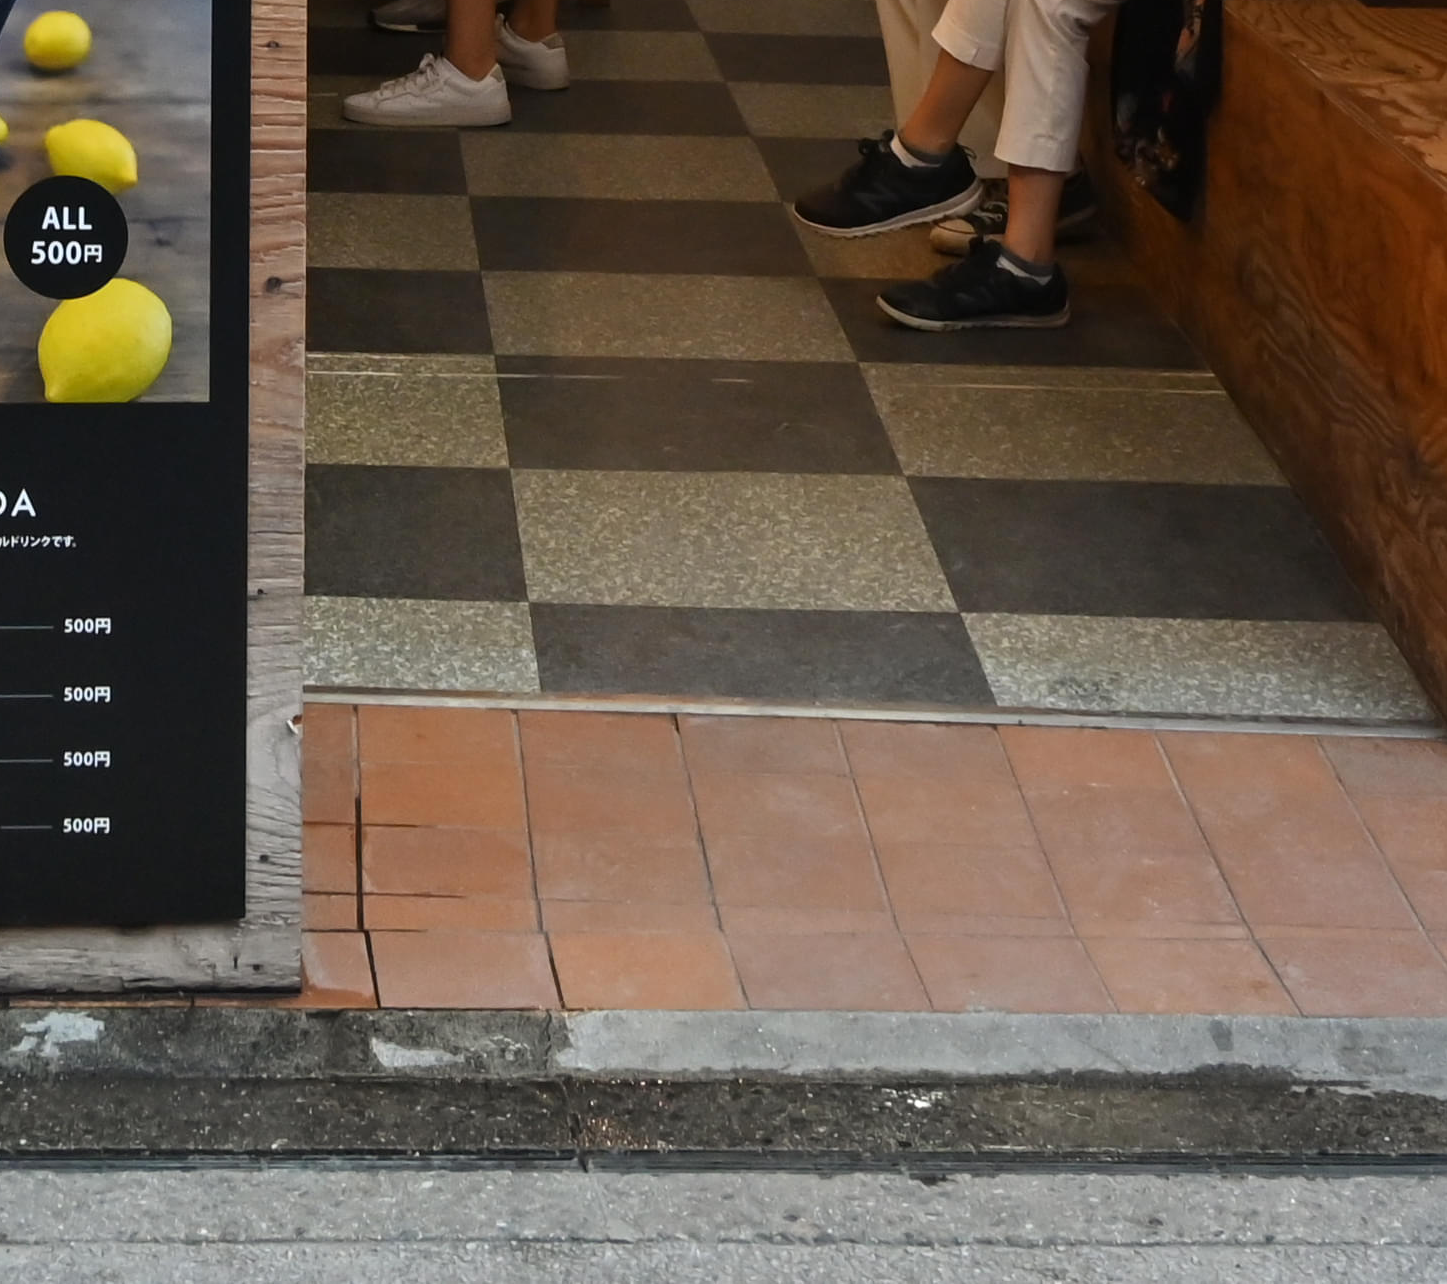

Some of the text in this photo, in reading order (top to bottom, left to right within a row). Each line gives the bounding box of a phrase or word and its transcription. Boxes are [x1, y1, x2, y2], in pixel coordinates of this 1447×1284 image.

[41, 205, 93, 231] ALL
[30, 240, 103, 265] 500円
[63, 617, 112, 635] 500円
[63, 685, 111, 703] 500円
[63, 750, 111, 768] 500円
[62, 816, 111, 834] 500円
